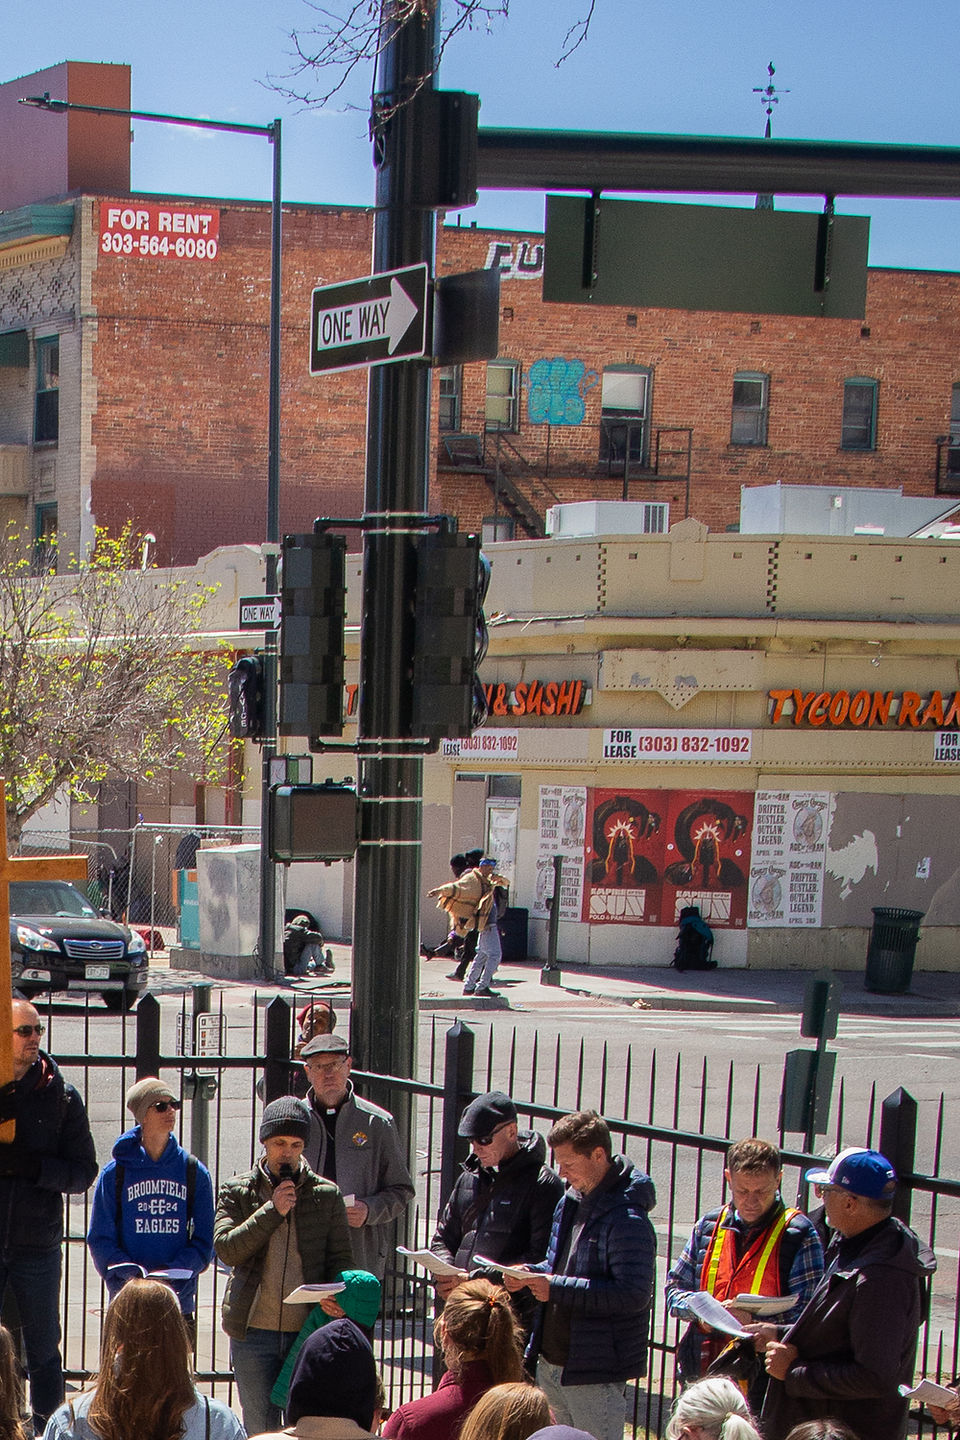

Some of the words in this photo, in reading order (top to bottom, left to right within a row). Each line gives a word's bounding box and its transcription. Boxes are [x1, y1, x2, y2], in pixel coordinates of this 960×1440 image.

[108, 209, 150, 230] FOR
[158, 212, 212, 234] RENT
[102, 232, 217, 259] 303-564-6080
[322, 309, 353, 345] ONE
[359, 301, 391, 338] WAY
[243, 608, 257, 621] ONE
[260, 606, 275, 620] WAY
[493, 682, 509, 716] &
[512, 680, 583, 716] SUSHI
[770, 689, 893, 726] TYCOON
[482, 736, 518, 750] 832-1092
[610, 730, 632, 743] FOR
[638, 736, 678, 752] (303)
[681, 737, 749, 752] 832-1092
[941, 733, 958, 746] FOR
[443, 743, 460, 756] LEASE
[604, 745, 637, 758] LEASE
[590, 895, 645, 916] SUN
[127, 1180, 187, 1202] BROOMFIELD
[137, 1202, 148, 1211] 20
[166, 1202, 178, 1211] 24
[135, 1219, 180, 1233] EAGLES
